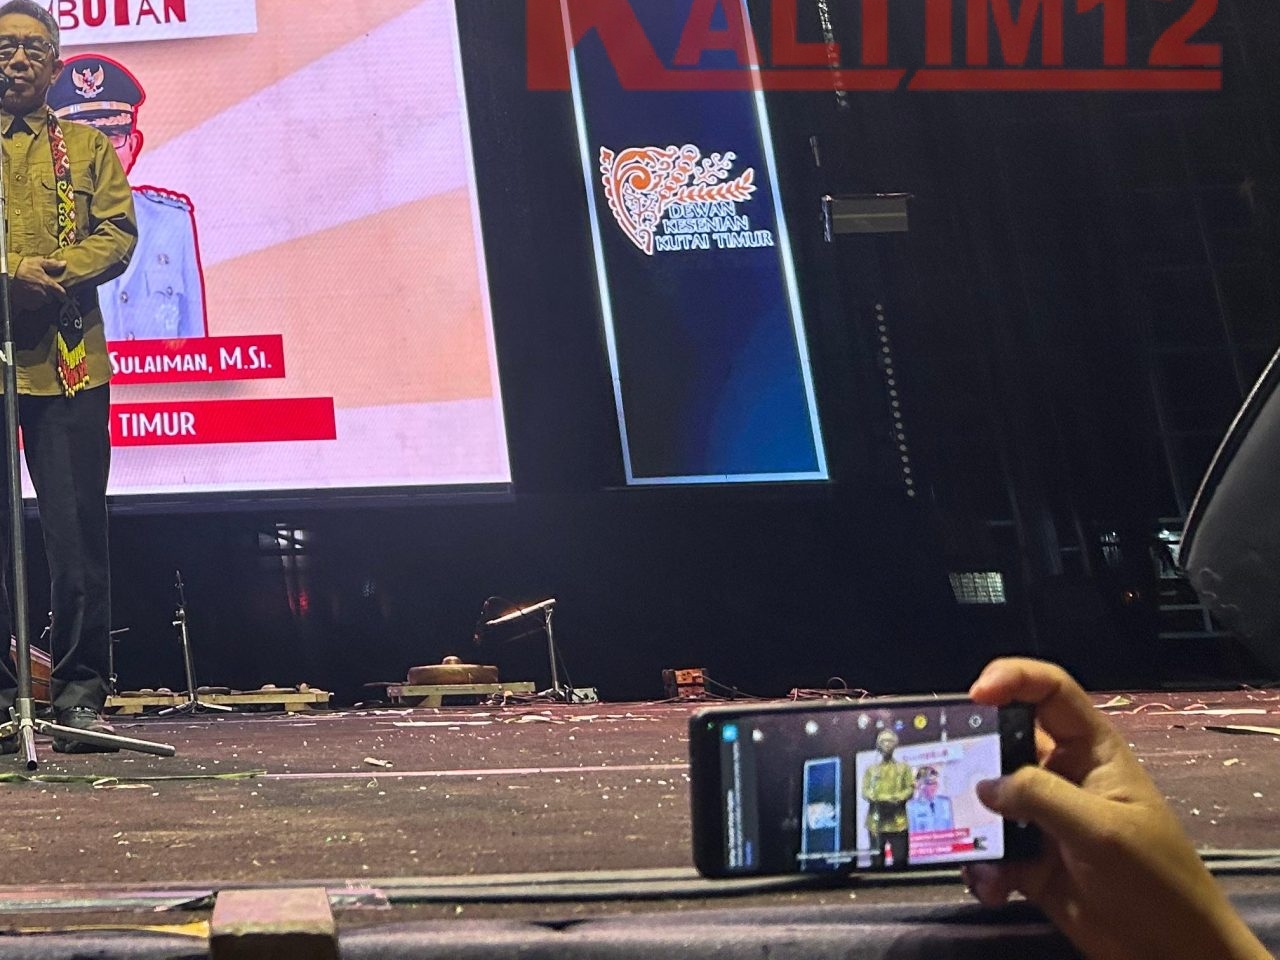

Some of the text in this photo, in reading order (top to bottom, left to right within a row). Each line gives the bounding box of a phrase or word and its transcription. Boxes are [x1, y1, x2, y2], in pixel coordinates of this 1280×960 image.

[668, 202, 735, 217] DEWAN
[663, 215, 749, 234] KESENIAN
[656, 230, 774, 251] KUTAI TIMUR
[118, 411, 197, 438] TIMUR
